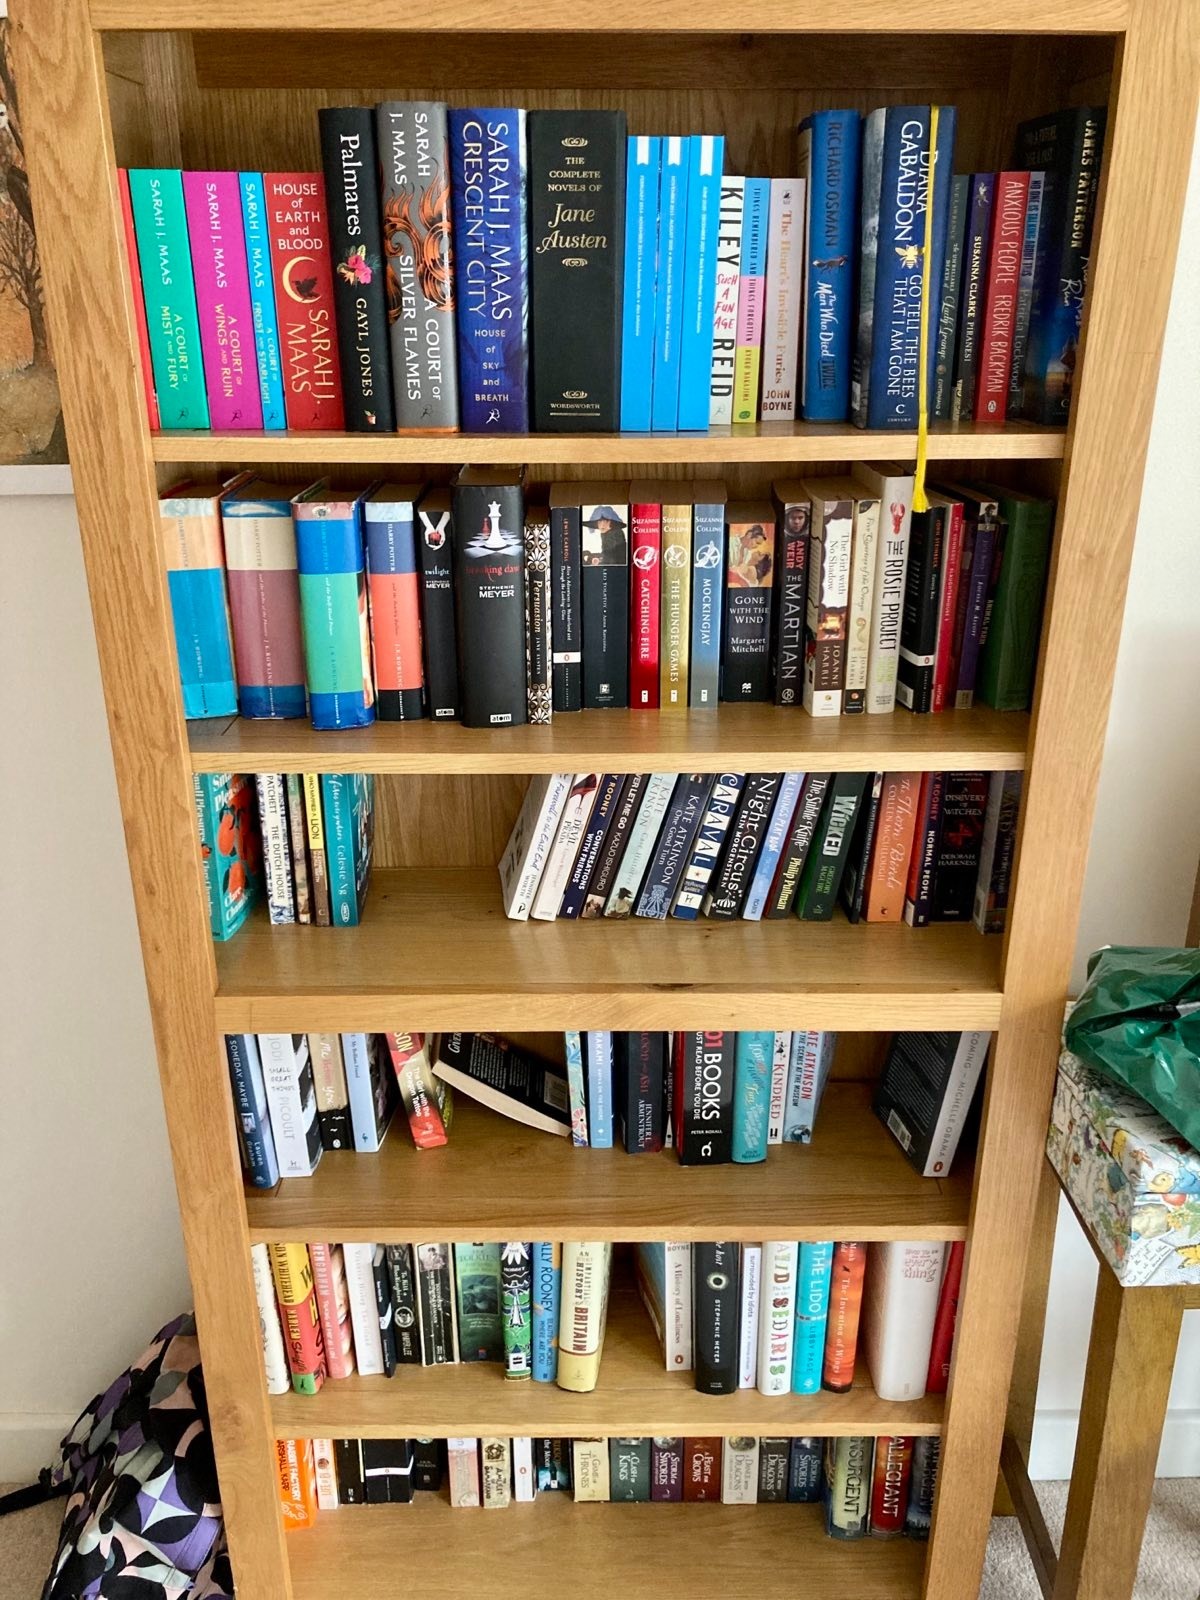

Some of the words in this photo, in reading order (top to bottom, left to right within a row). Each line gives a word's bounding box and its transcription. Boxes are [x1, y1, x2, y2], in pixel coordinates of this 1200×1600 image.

[388, 113, 406, 123] J.
[392, 130, 408, 186] MAAS
[414, 112, 432, 176] SARAH
[1080, 120, 1094, 166] JAMES
[338, 133, 364, 236] Palmares
[486, 122, 510, 212] SARAH
[549, 170, 601, 179] COMPLETE
[894, 120, 923, 242] GABALDON
[916, 150, 938, 214] DIANA
[273, 184, 318, 196] HOUSE
[462, 120, 486, 252] CRESCENT
[276, 212, 320, 223] EARTH
[548, 203, 596, 228] Jane
[824, 190, 841, 246] OSMAN
[1000, 181, 1020, 236] ANXIOUS
[1070, 171, 1092, 248] PATTERSON
[150, 179, 164, 229] SARAH
[158, 245, 172, 285] MAAS
[206, 182, 219, 230] SARAH
[214, 248, 228, 288] MAAS
[246, 182, 258, 230] SARAH
[254, 248, 265, 288] MAAS
[278, 238, 323, 250] BLOOD
[485, 222, 508, 235] J.
[536, 230, 608, 254] Austen
[717, 186, 744, 268] KILEY
[996, 242, 1016, 284] PEOPLE
[399, 255, 416, 321] SILVER
[468, 260, 487, 318] CITY
[491, 245, 512, 320] MAAS
[892, 276, 908, 317] THAT
[908, 274, 922, 298] GO
[356, 298, 369, 342] GAYL
[424, 298, 438, 310] A
[906, 302, 920, 332] TELL
[991, 294, 1012, 336] FREDRIK
[286, 322, 312, 393] MAAS
[308, 309, 334, 387] SARAH
[426, 319, 442, 382] COURT
[890, 329, 904, 351] AM
[904, 336, 918, 364] THE
[356, 345, 374, 398] JONES
[404, 327, 421, 401] FLAMES
[710, 338, 733, 398] REID
[886, 354, 902, 396] GONE
[986, 341, 1006, 392] BACKMAN
[311, 392, 335, 404] J.
[900, 368, 916, 398] BEES
[786, 542, 795, 569] WEIR
[795, 540, 804, 570] ANDY
[830, 540, 838, 555] No
[840, 534, 850, 552] The
[886, 540, 905, 556] THE
[828, 556, 838, 592] Shadow
[839, 553, 849, 572] Girl
[478, 590, 515, 598] MEYER
[670, 579, 680, 600] THE
[735, 596, 766, 604] GONE
[838, 574, 848, 596] with
[640, 580, 650, 635] CATCHING
[670, 603, 680, 648] HUNGER
[700, 578, 712, 646] MOCKINGJAY
[734, 616, 764, 624] WIND
[731, 637, 766, 645] Margaret
[782, 582, 801, 679] MARTIAN
[879, 603, 900, 651] PROJECT
[640, 638, 650, 659] FIRE
[670, 650, 679, 682] GAMES
[820, 646, 830, 686] HARRIS
[831, 644, 840, 686] JOANNE
[266, 775, 277, 814] PATCHETT
[599, 782, 616, 817] ROONEY
[744, 777, 776, 832] Night
[780, 788, 796, 817] LININGS
[810, 780, 827, 794] The
[682, 794, 700, 823] KATE
[692, 774, 739, 864] CARAVAL
[738, 810, 749, 828] ERIN
[802, 794, 822, 820] Subtle
[894, 796, 913, 836] Thorn
[272, 825, 280, 840] THE
[567, 819, 582, 846] DEVIL
[582, 832, 594, 852] WITH
[791, 820, 813, 852] Knife
[924, 830, 936, 867] NORMAL
[272, 844, 282, 870] DUTCH
[572, 852, 587, 883] FRIENDS
[578, 830, 604, 890] CONVERSATIONS
[661, 826, 688, 884] ATKINSON
[720, 831, 742, 888] MORGENSTERN
[728, 834, 758, 890] Circus
[784, 857, 802, 880] Philip
[887, 843, 906, 890] Birds
[276, 874, 286, 900] HOUSE
[776, 880, 798, 910] Pullman
[920, 870, 931, 900] PEOPLE
[806, 1032, 819, 1050] ATE
[702, 1053, 722, 1120] BOOKS
[801, 1051, 817, 1089] ATKINSON
[770, 1063, 785, 1120] KINDRED
[280, 1096, 296, 1140] PICOULT
[246, 1140, 256, 1167] Graham
[254, 1141, 264, 1166] Lauren
[575, 1262, 584, 1300] HISTORY
[584, 1262, 592, 1300] IMPARTIAL
[811, 1248, 827, 1278] THE
[277, 1260, 294, 1303] WHITEHEAD
[392, 1264, 402, 1302] Mockingbird
[540, 1266, 552, 1312] ROONEY
[808, 1280, 824, 1314] LIDO
[286, 1309, 301, 1340] HARLEM
[572, 1306, 588, 1352] BRITAIN
[769, 1298, 793, 1376] SEDARIS
[290, 1341, 306, 1372] Shuffle
[286, 1439, 300, 1466] RABBIT
[580, 1450, 592, 1488] THRONES
[619, 1454, 630, 1481] KINGS
[659, 1452, 671, 1486] SWORDS
[692, 1453, 704, 1482] CROWS
[281, 1473, 290, 1492] KARP
[290, 1468, 302, 1502] FACTORY
[735, 1454, 744, 1491] DRAGONS
[767, 1454, 778, 1490] DRAGONS
[798, 1454, 812, 1488] SWORDS
[882, 1436, 905, 1518] ALLEGIANT
